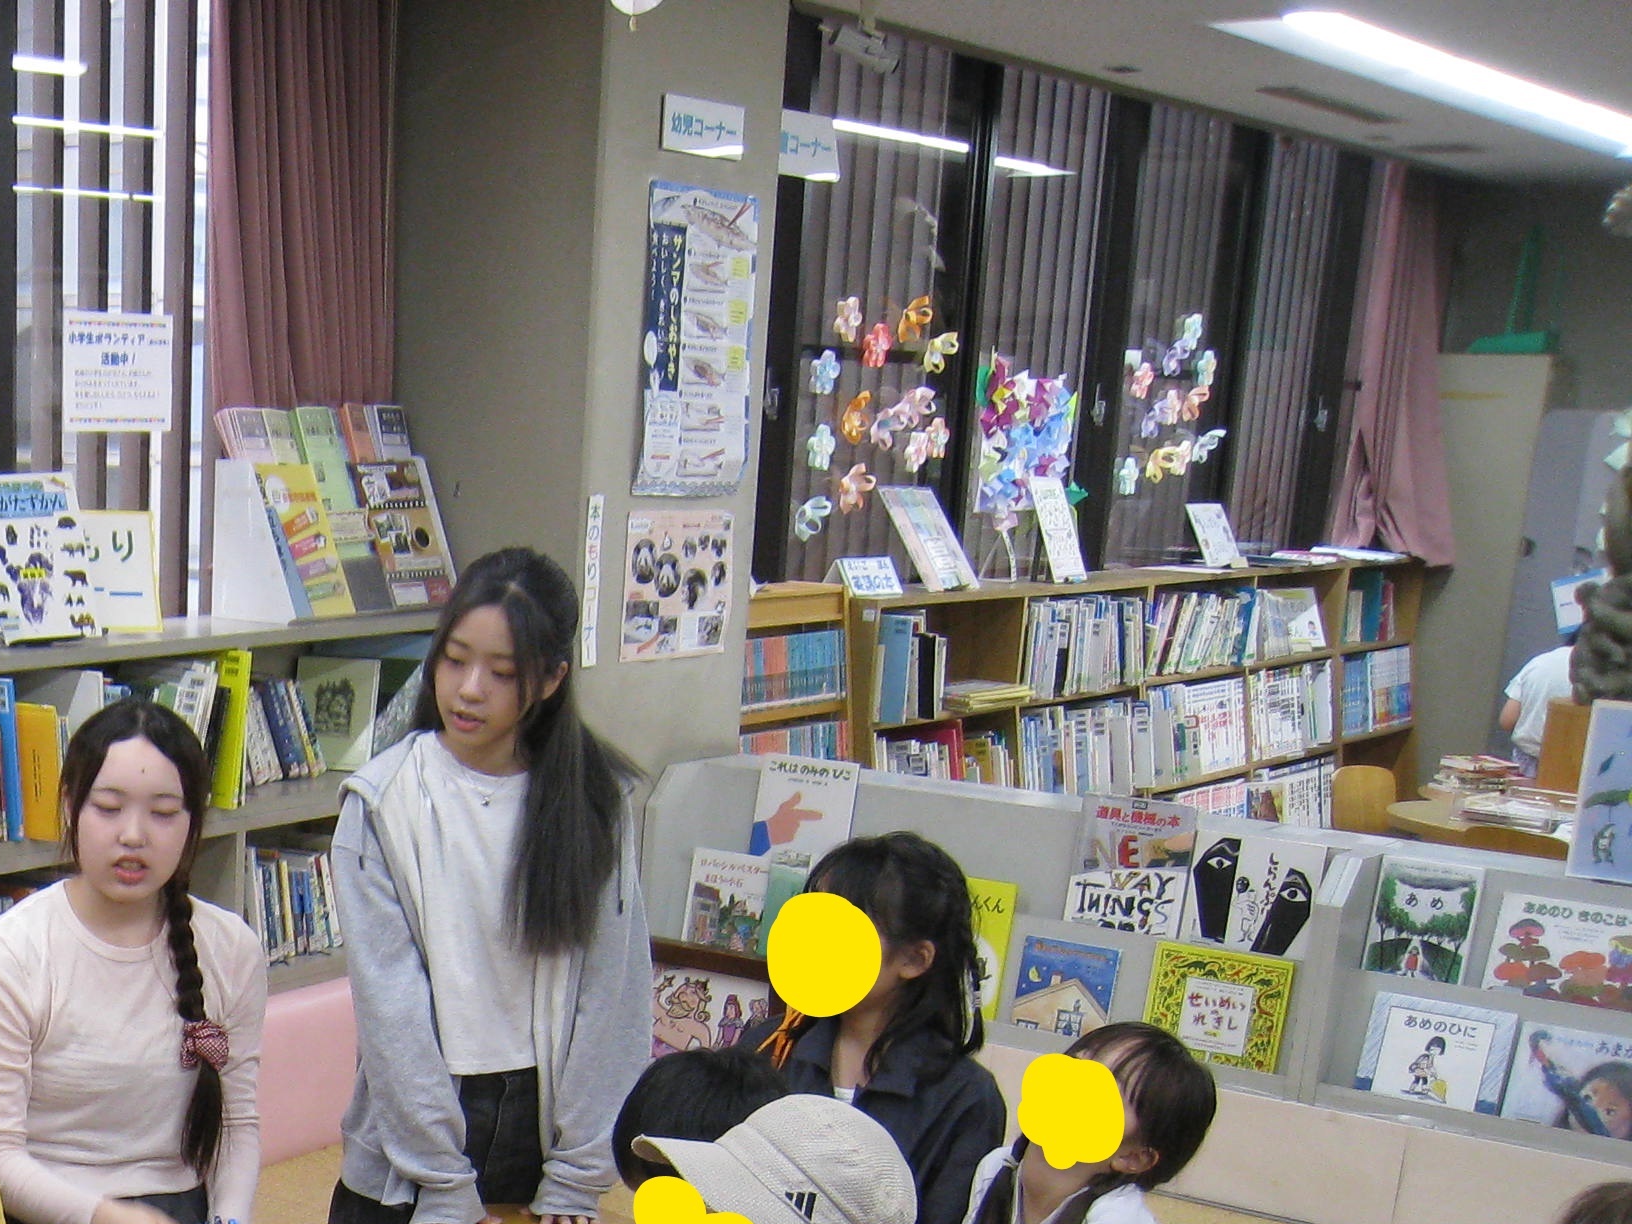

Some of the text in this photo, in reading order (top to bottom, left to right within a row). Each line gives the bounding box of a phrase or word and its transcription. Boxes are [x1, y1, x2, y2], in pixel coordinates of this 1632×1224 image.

[671, 111, 737, 141] 幼児コーナー
[583, 505, 602, 660] 本のもり コーナー
[1096, 805, 1181, 828] 道具と機械の本
[1404, 891, 1444, 911] あめ
[1522, 901, 1574, 919] あめのひ
[1188, 992, 1246, 1011] せいめい
[1192, 1011, 1239, 1030] れきし
[1404, 1014, 1478, 1039] あめのひに
